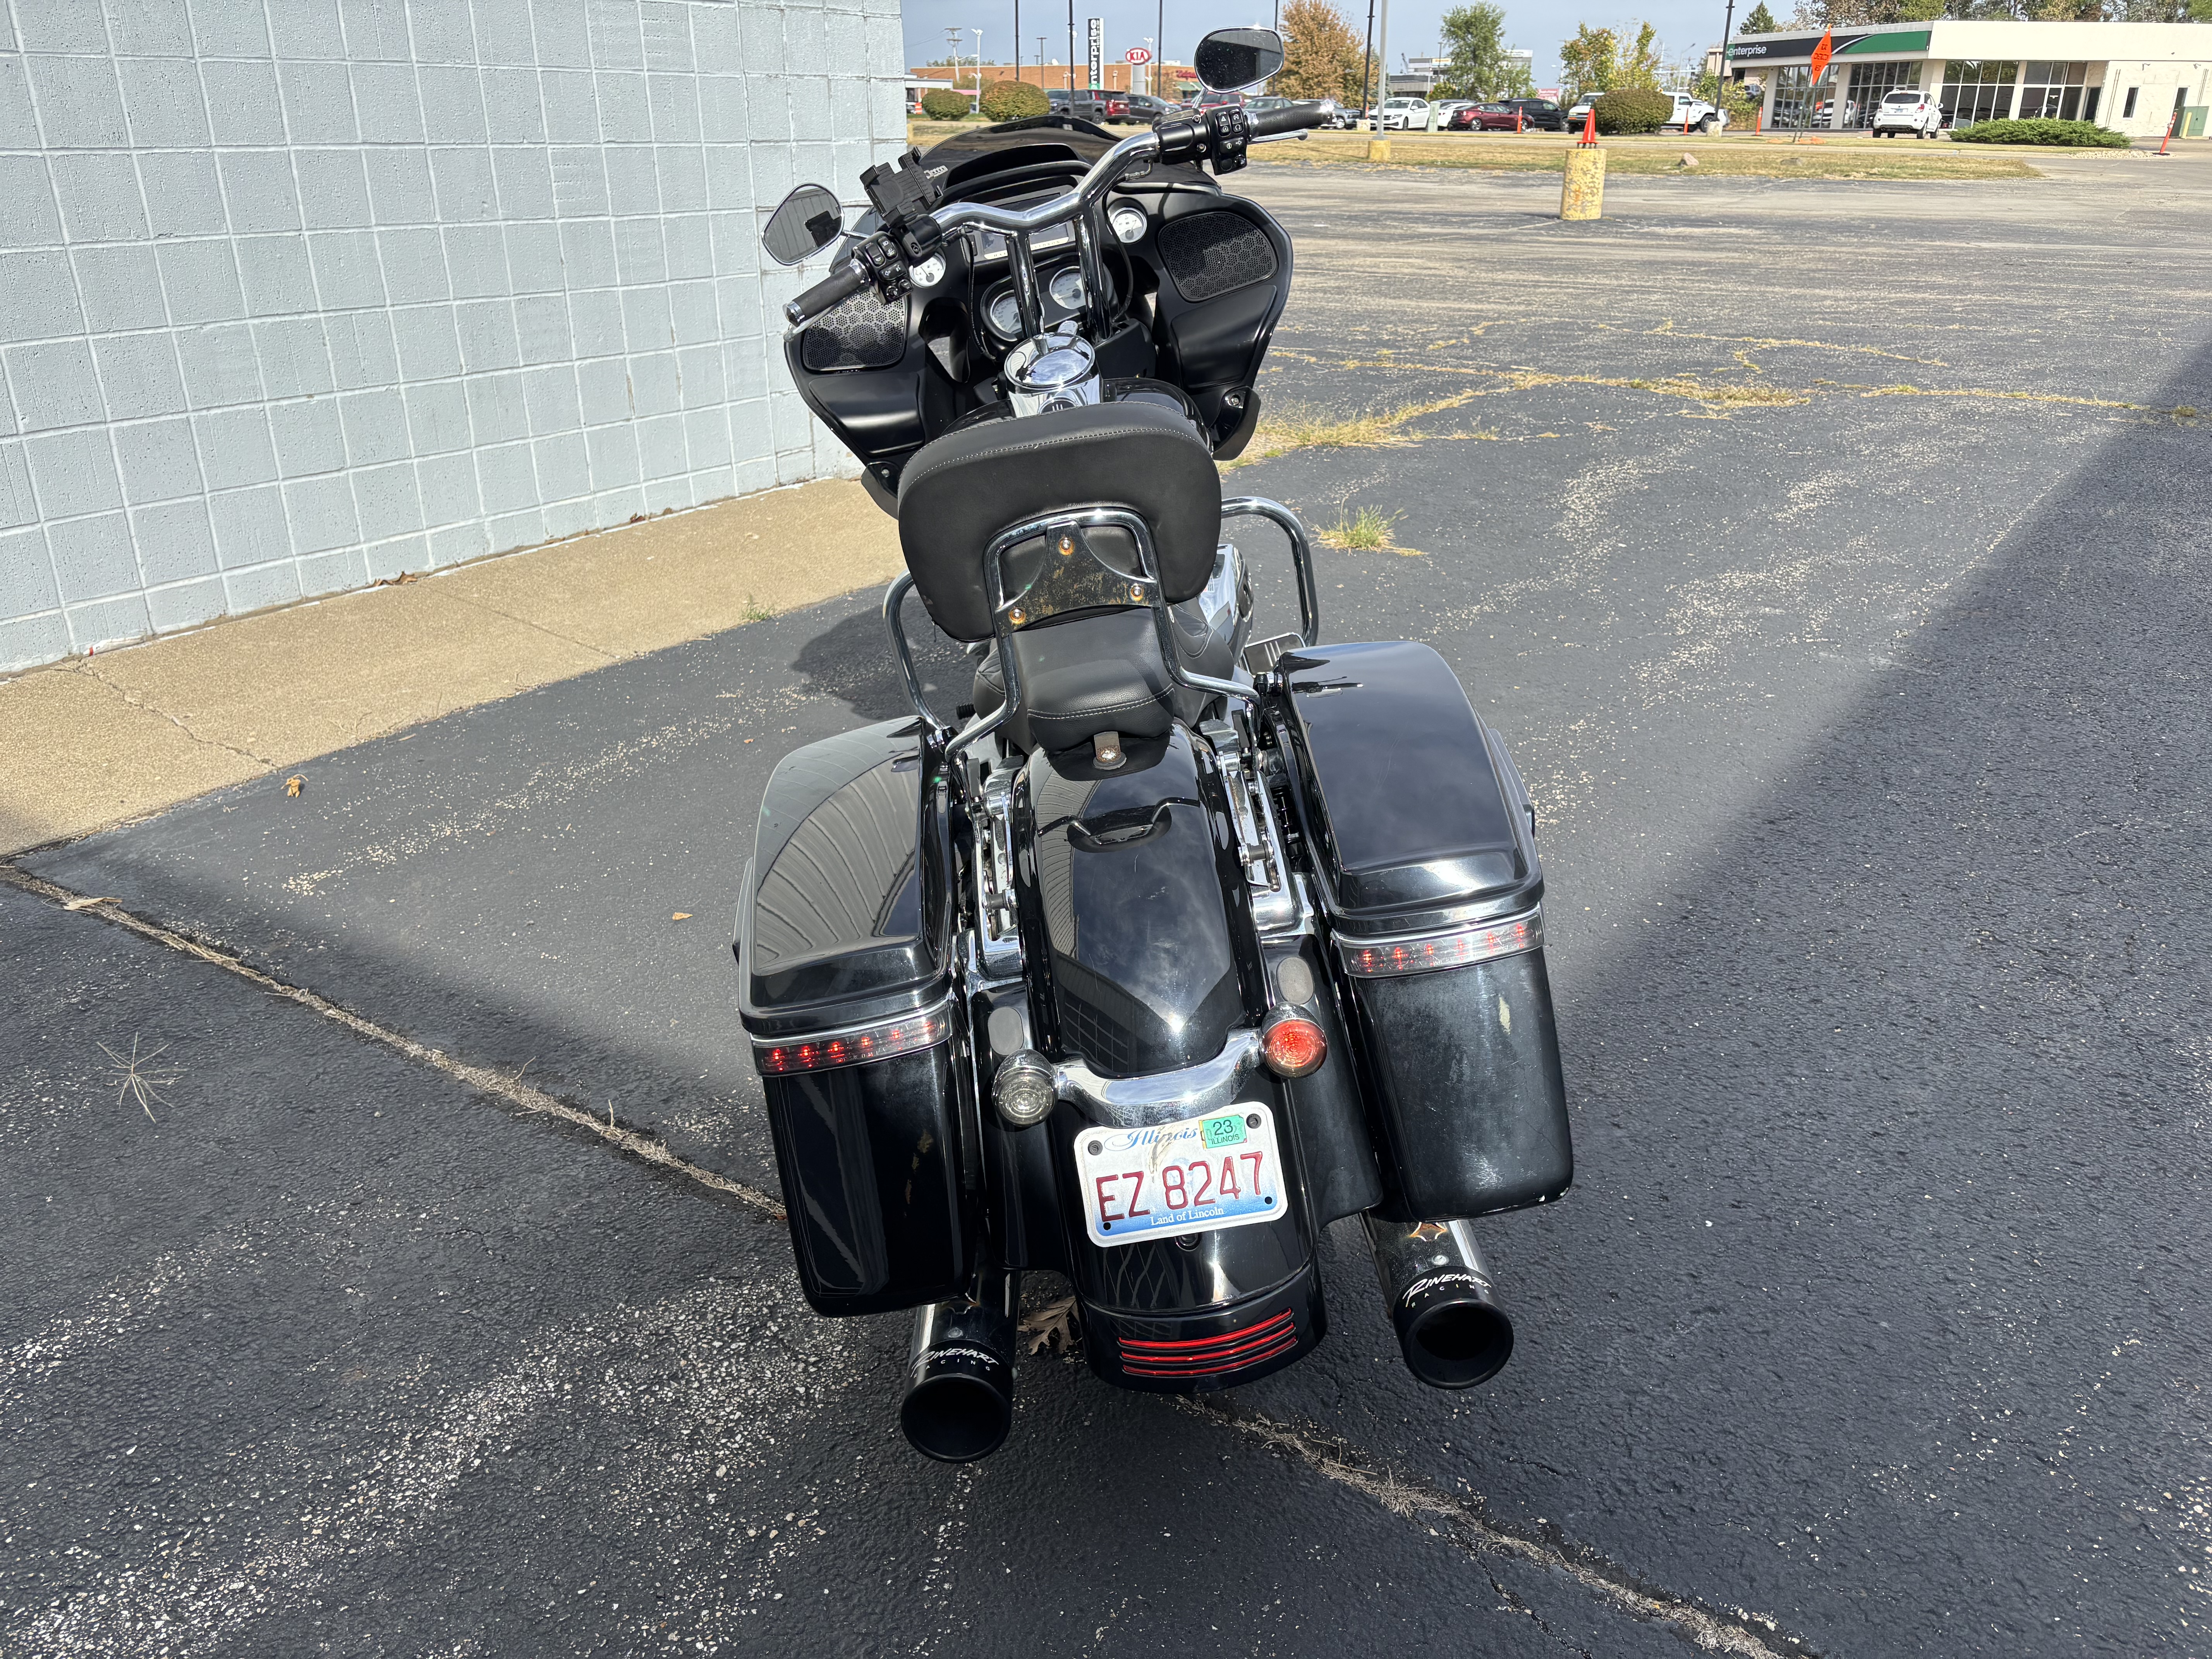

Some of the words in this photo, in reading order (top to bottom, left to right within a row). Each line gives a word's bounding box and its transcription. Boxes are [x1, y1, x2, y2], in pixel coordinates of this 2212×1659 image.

[1130, 52, 1146, 61] KIA
[1728, 45, 1767, 57] enterprise
[1213, 1119, 1233, 1136] 23
[1104, 1128, 1198, 1151] Illinois
[1211, 1134, 1240, 1145] ILLINOIS
[1096, 1171, 1151, 1221] EZ
[1162, 1151, 1263, 1210] 8247
[1150, 1214, 1174, 1226] Land
[1176, 1211, 1187, 1221] of
[1188, 1206, 1224, 1220] Lincoln
[1403, 1274, 1492, 1307] RINEHART
[1412, 1284, 1489, 1308] RACING
[910, 1348, 999, 1377] RINEHART
